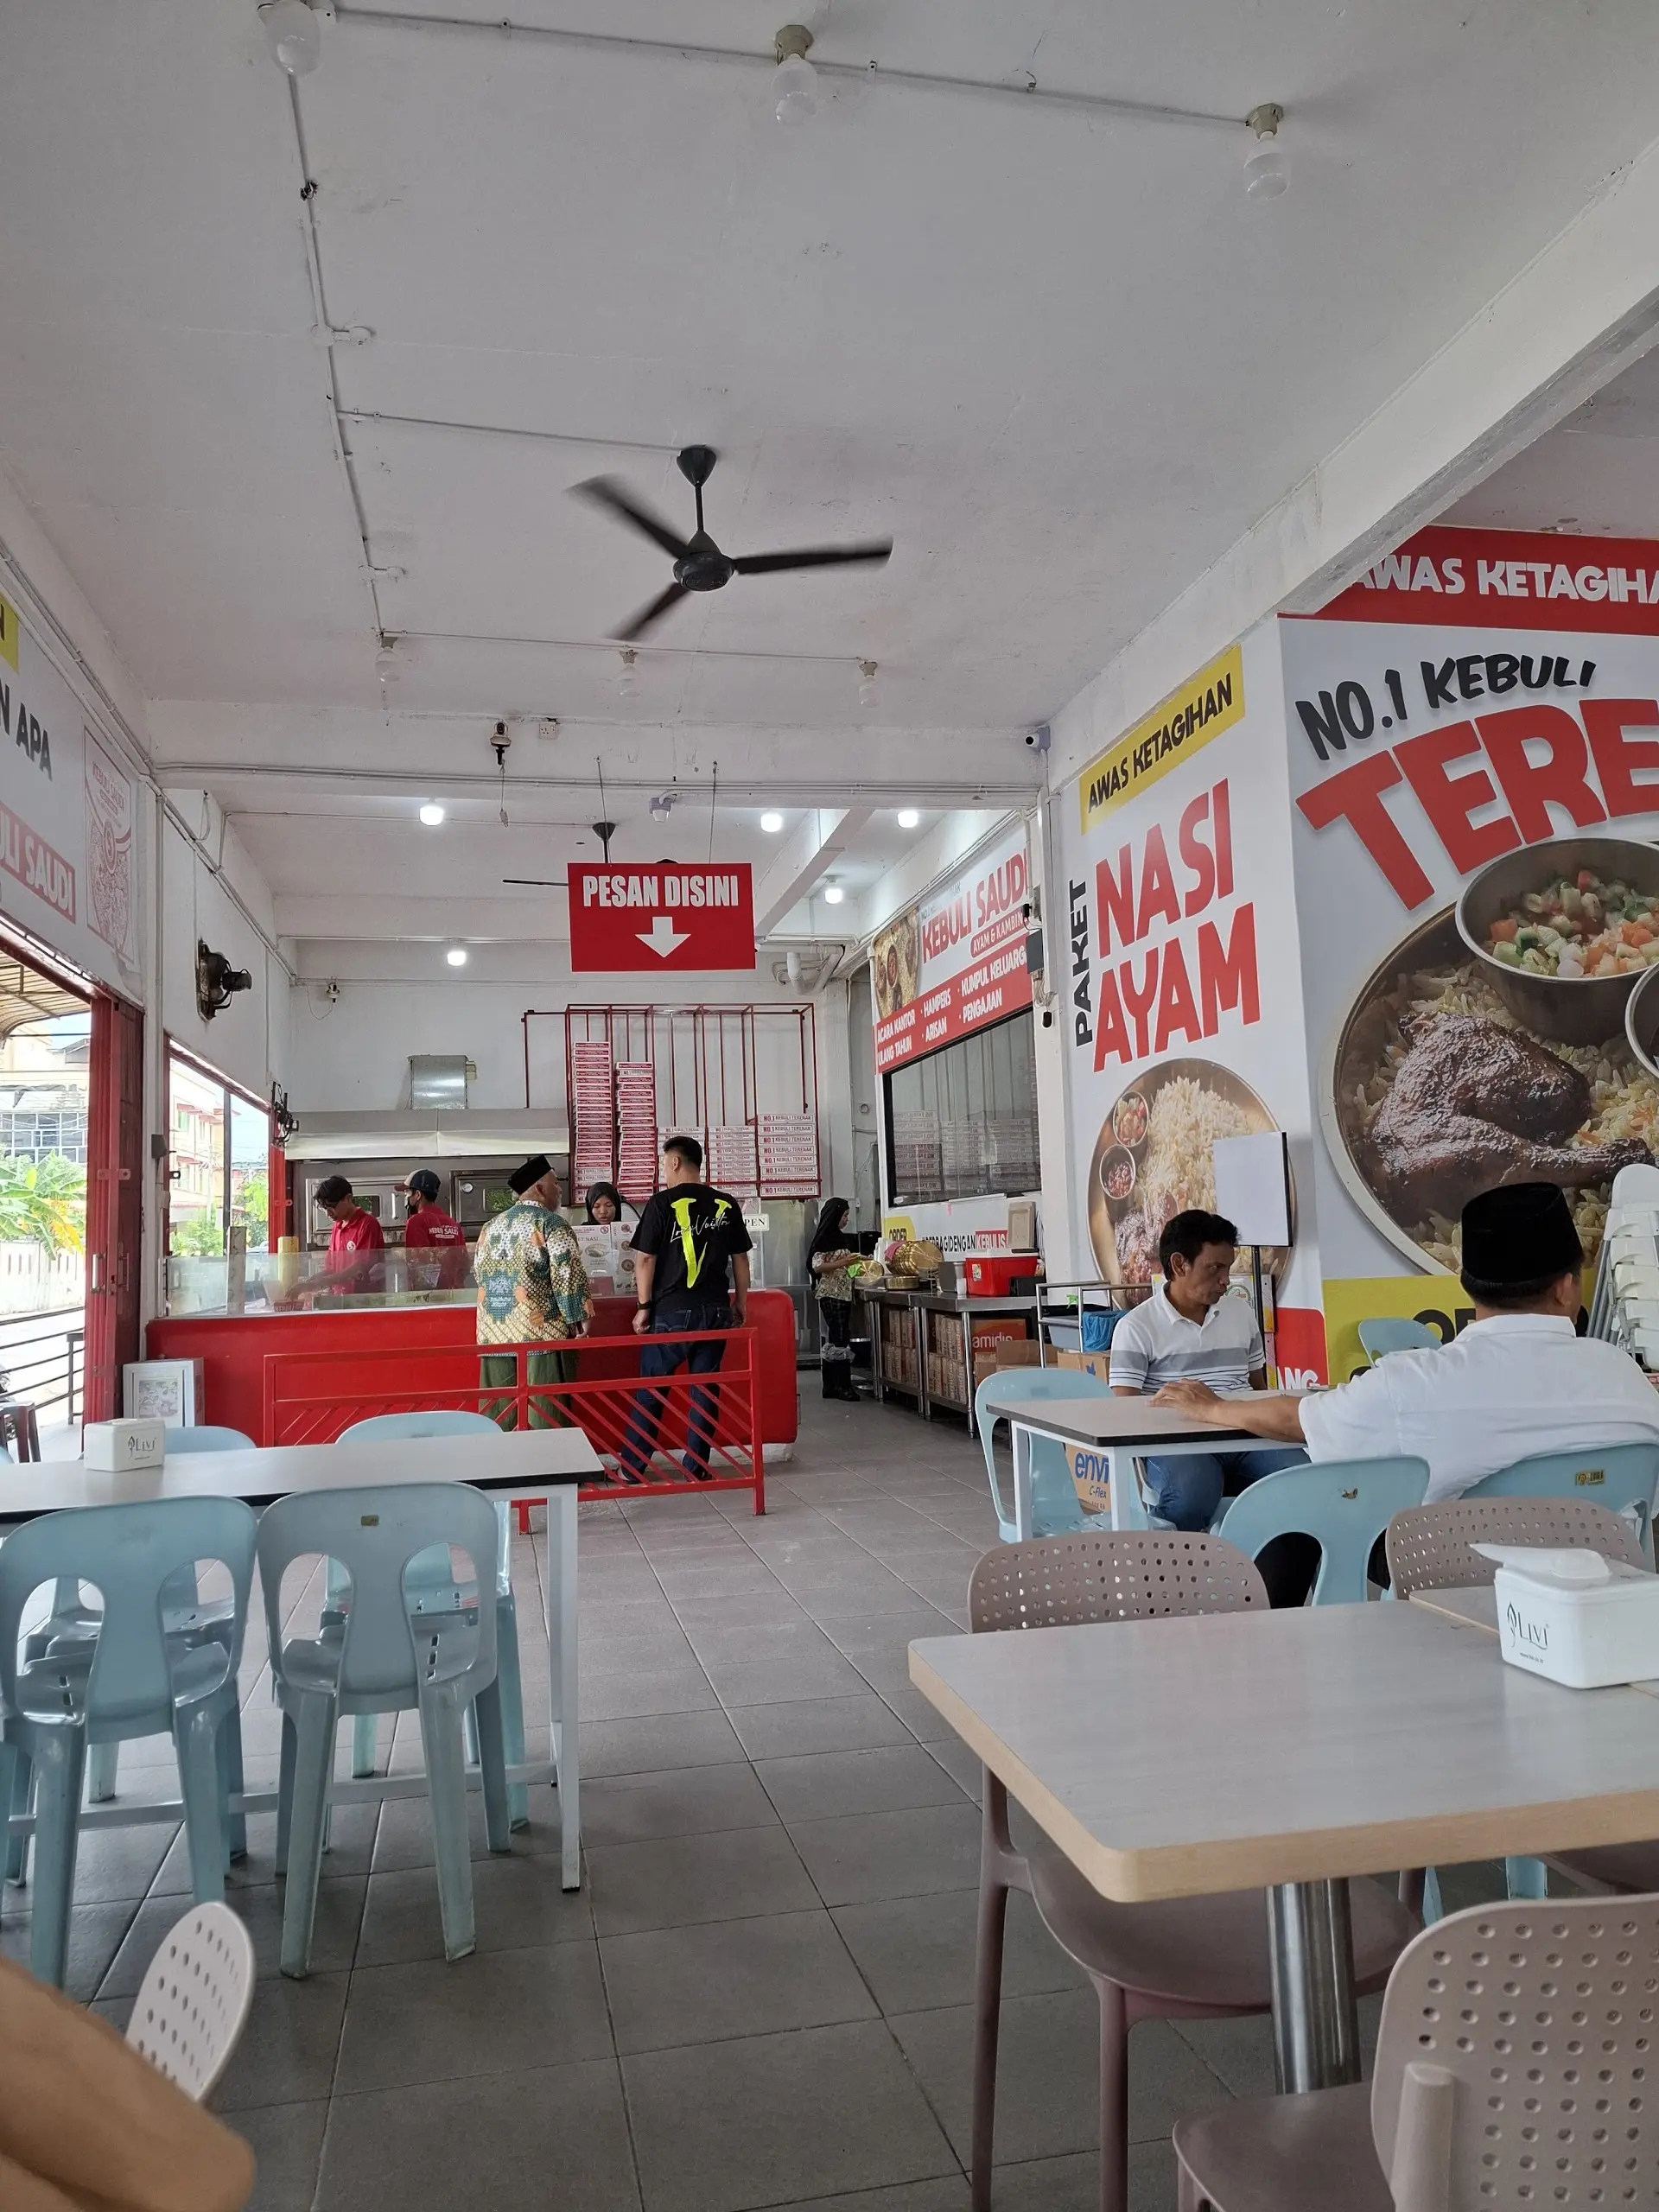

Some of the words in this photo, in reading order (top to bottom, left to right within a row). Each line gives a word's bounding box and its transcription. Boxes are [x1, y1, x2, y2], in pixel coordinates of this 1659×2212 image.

[16, 702, 53, 782] APA
[1088, 757, 1129, 814] AWAS
[1133, 671, 1233, 779] KETAGIHAN
[1294, 669, 1408, 761] NO.1
[1420, 653, 1597, 709] KEBULI
[25, 834, 73, 917] SAUDI
[582, 875, 659, 907] PESAN
[664, 875, 739, 907] DISINI
[921, 891, 972, 964] KEBULI
[976, 847, 1028, 929] SAUDI
[1095, 778, 1234, 960] NASI
[961, 965, 989, 997] KUMPUL
[990, 944, 1027, 982] KELUARG
[973, 933, 990, 955] AYAM
[996, 911, 1028, 940] KAMBIN
[1069, 880, 1093, 1047] PAKET
[924, 988, 951, 1019] HAMPERS
[963, 987, 1002, 1024] PENGAJIAN
[1093, 900, 1261, 1074] AYAM
[744, 1218, 765, 1227] PEN
